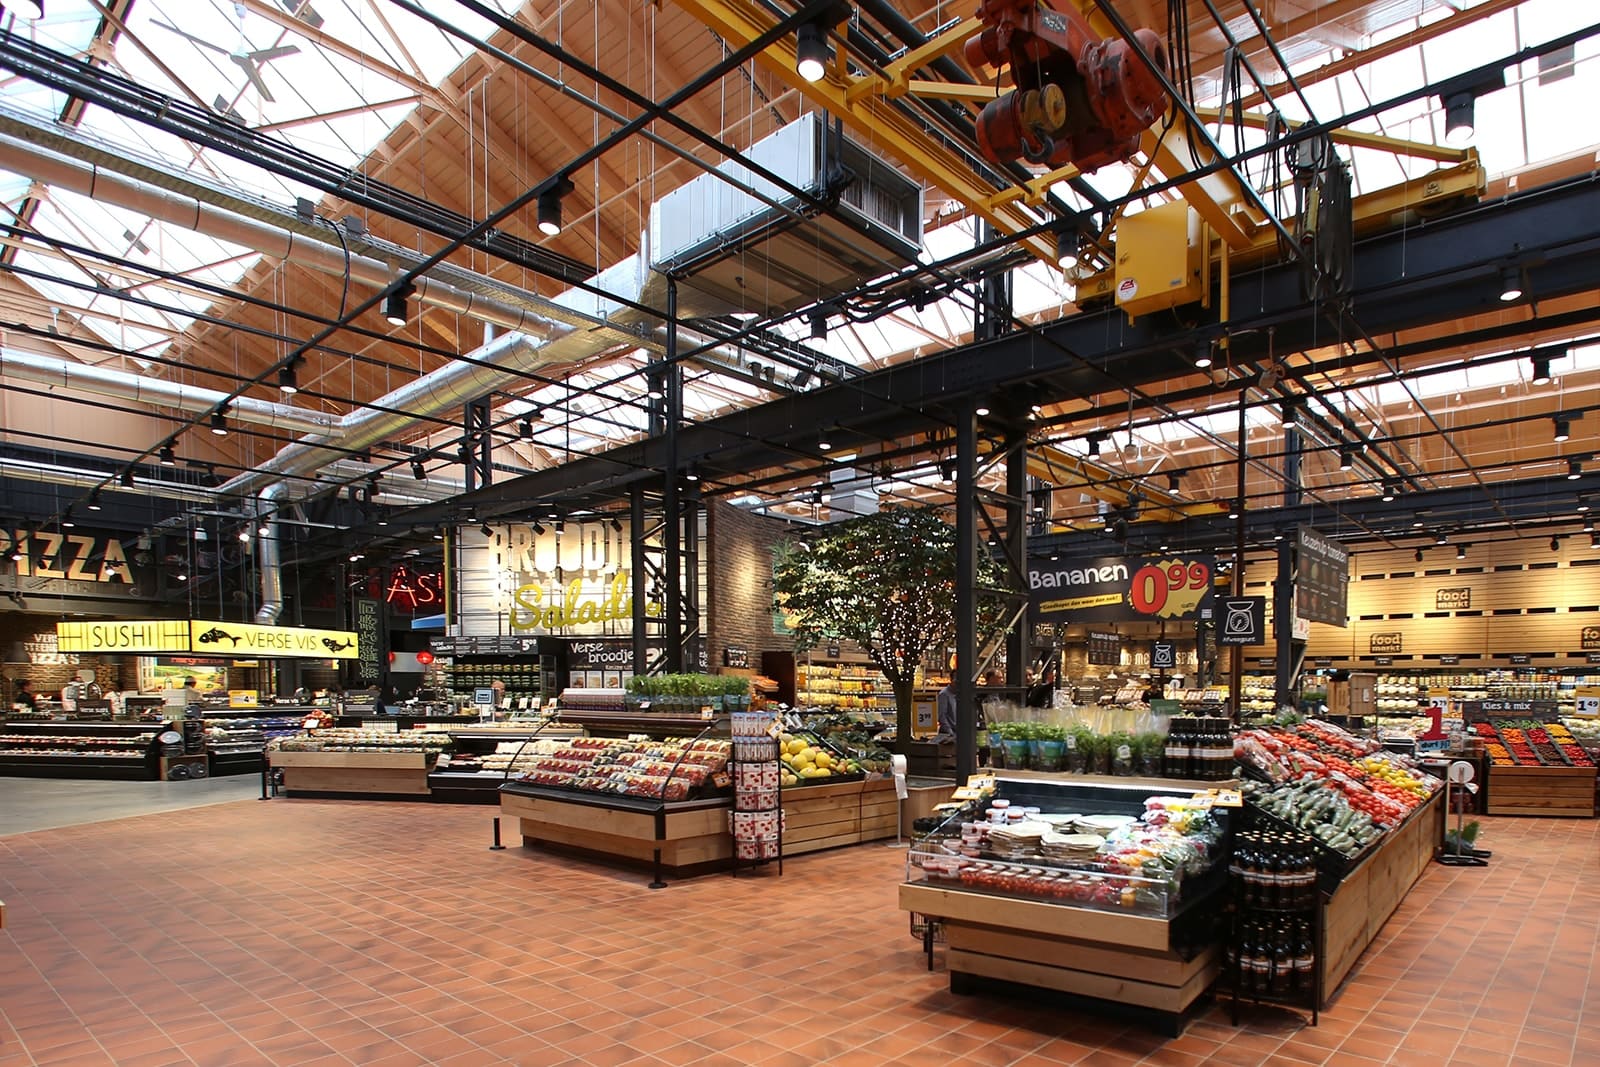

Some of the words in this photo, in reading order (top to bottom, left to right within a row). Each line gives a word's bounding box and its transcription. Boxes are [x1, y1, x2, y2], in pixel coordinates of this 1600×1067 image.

[1029, 564, 1128, 590] Bananen
[1437, 589, 1469, 601] food
[92, 625, 152, 648] SUSHI
[245, 631, 291, 649] VERSE
[295, 635, 318, 650] VIS
[1371, 633, 1400, 645] food
[571, 642, 604, 654] Verse
[588, 649, 634, 664] broodje
[1482, 702, 1501, 710] Kies
[1504, 702, 1511, 710] &
[1513, 701, 1531, 710] mix
